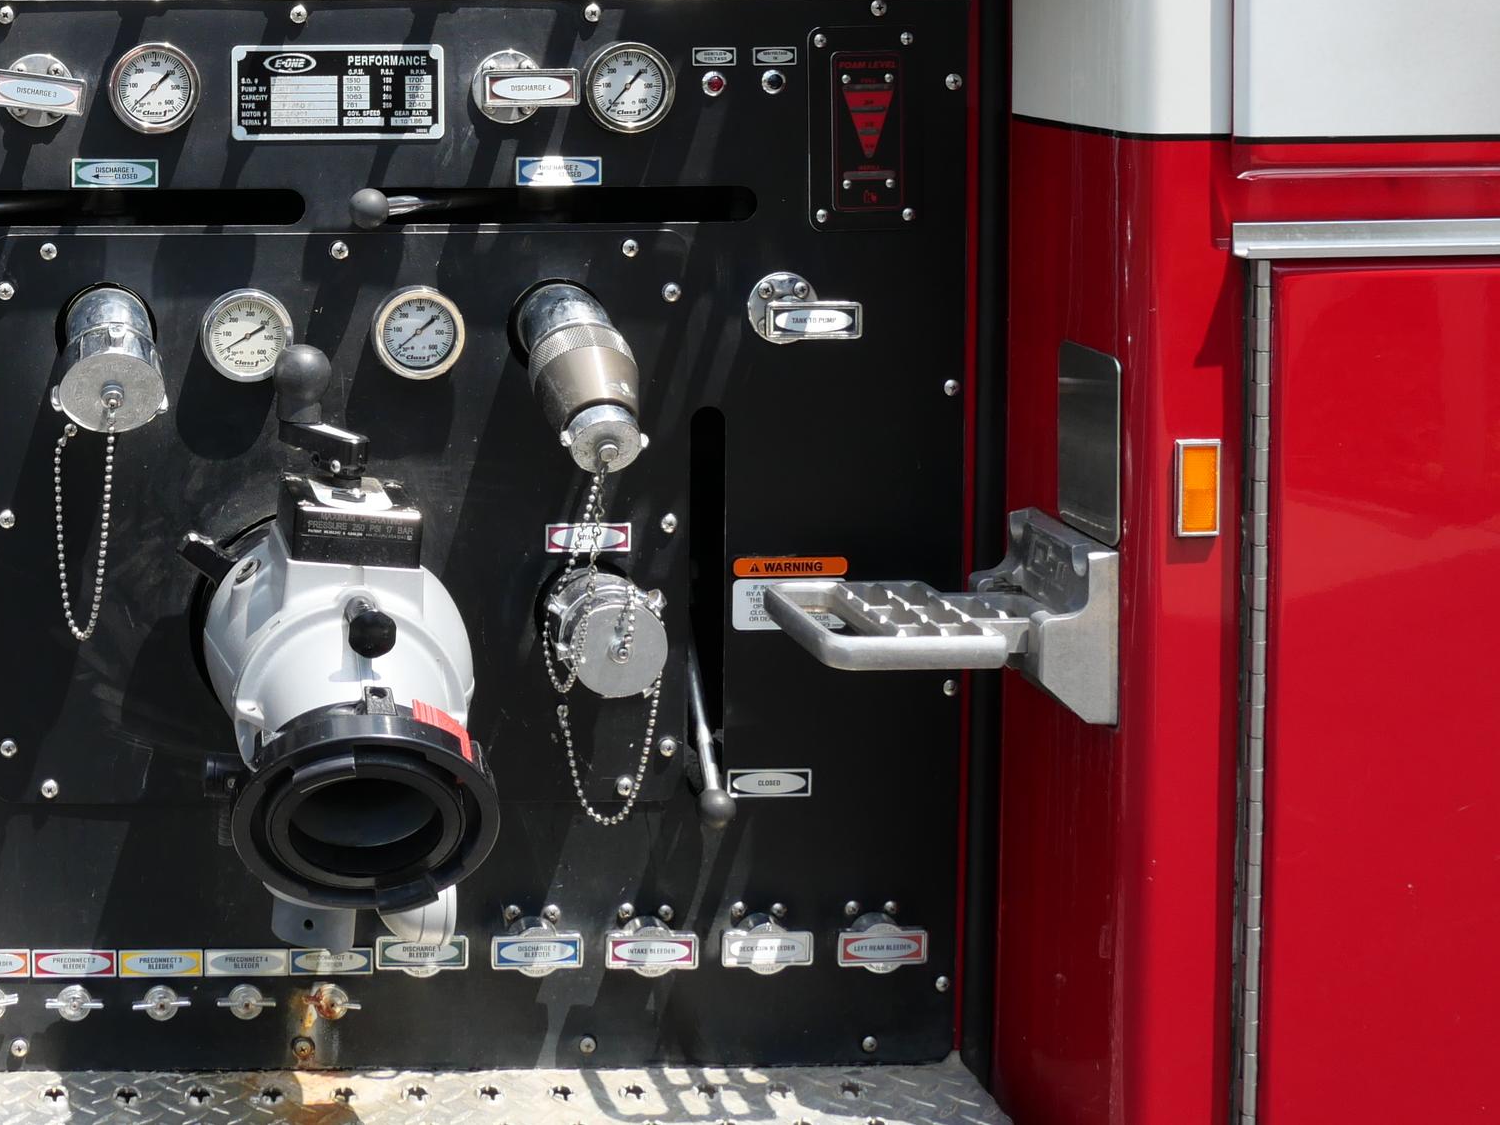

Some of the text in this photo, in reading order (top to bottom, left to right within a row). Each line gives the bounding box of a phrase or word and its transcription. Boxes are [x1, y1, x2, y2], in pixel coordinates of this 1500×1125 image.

[348, 55, 428, 67] PERFORMANCE
[867, 61, 897, 69] LEVEL
[16, 86, 52, 98] DISCHARGE
[511, 84, 547, 92] DISCHARGE
[307, 520, 348, 530] PRESSURE
[352, 524, 366, 532] 250
[369, 525, 382, 533] PSI
[398, 527, 414, 535] BAR
[764, 562, 823, 572] WARNING
[758, 779, 781, 787] CLOSED
